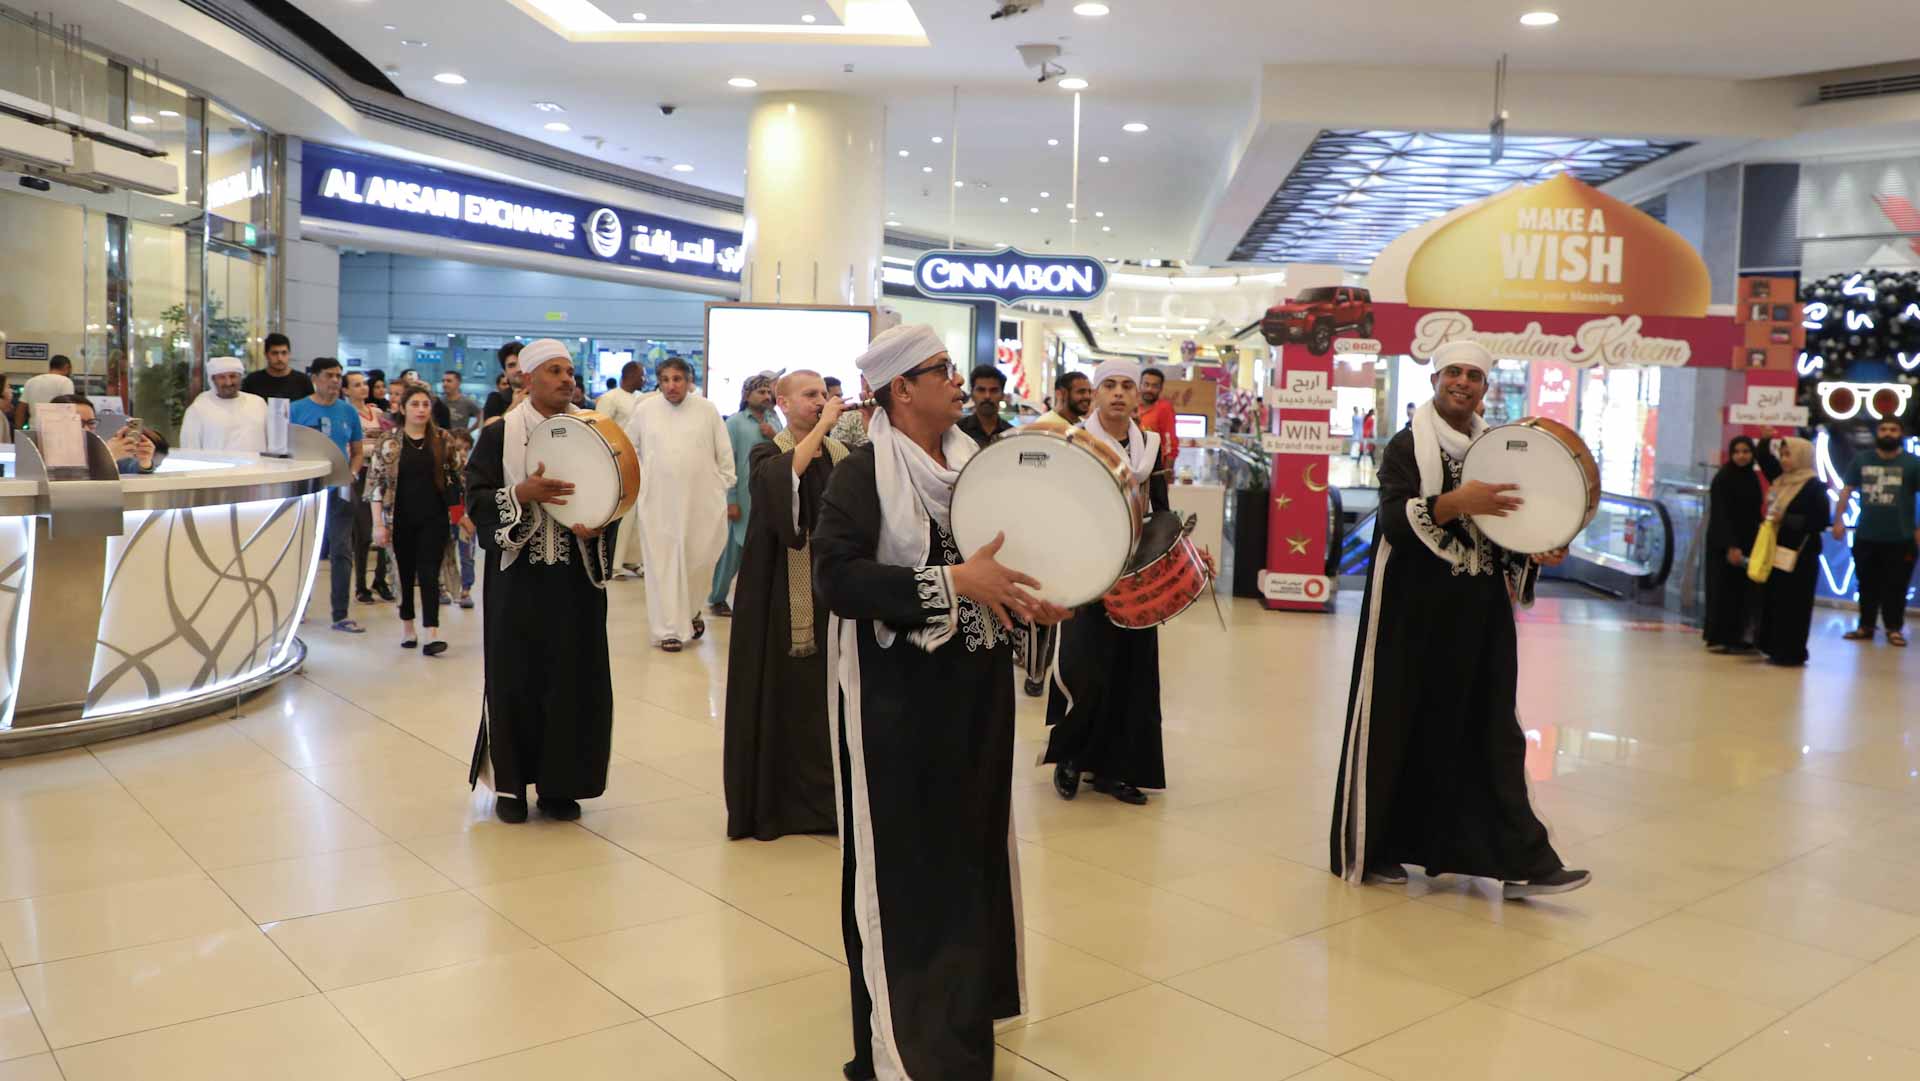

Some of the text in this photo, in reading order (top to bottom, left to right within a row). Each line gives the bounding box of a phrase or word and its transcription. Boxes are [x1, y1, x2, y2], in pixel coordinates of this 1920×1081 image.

[321, 168, 576, 240] AL ANSARI EXCHANGE
[1518, 207, 1606, 233] MAKE A
[921, 257, 1094, 293] CINNABON
[1500, 233, 1624, 284] WISH
[1286, 424, 1321, 441] WIN
